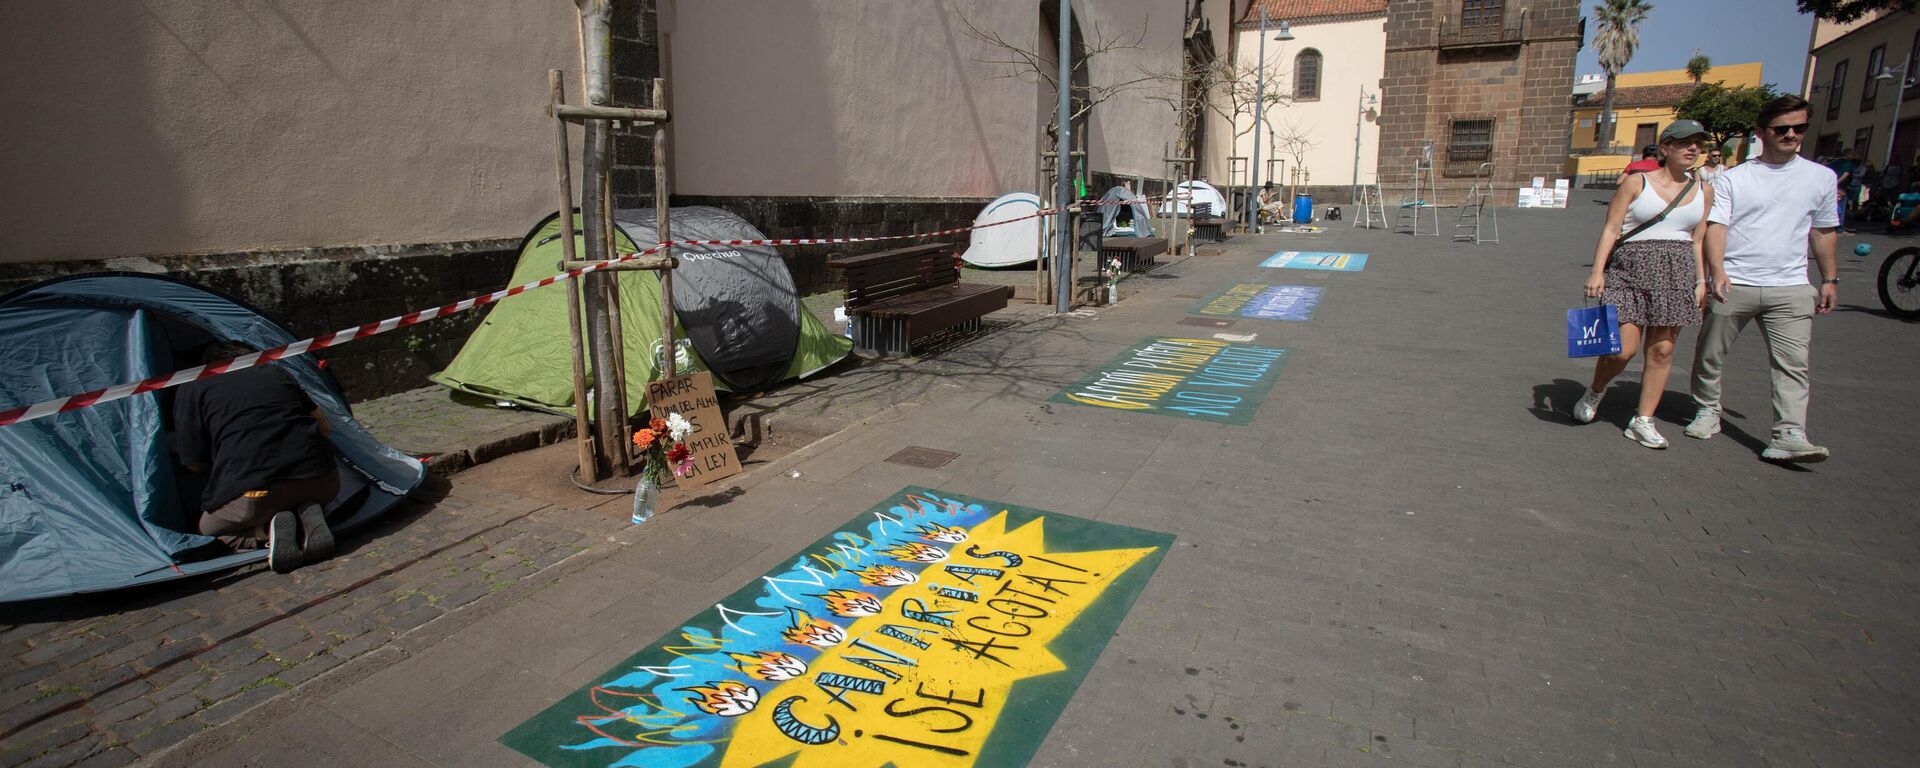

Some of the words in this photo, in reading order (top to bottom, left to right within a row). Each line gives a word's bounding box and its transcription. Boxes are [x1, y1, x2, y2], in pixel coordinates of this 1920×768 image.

[683, 249, 741, 262] Quechua
[650, 377, 697, 402] PARAR
[680, 400, 695, 414] DEL
[696, 396, 719, 410] ALMA
[1164, 391, 1242, 416] NO
[704, 452, 727, 471] LEY
[941, 555, 1101, 669] AGOTA!
